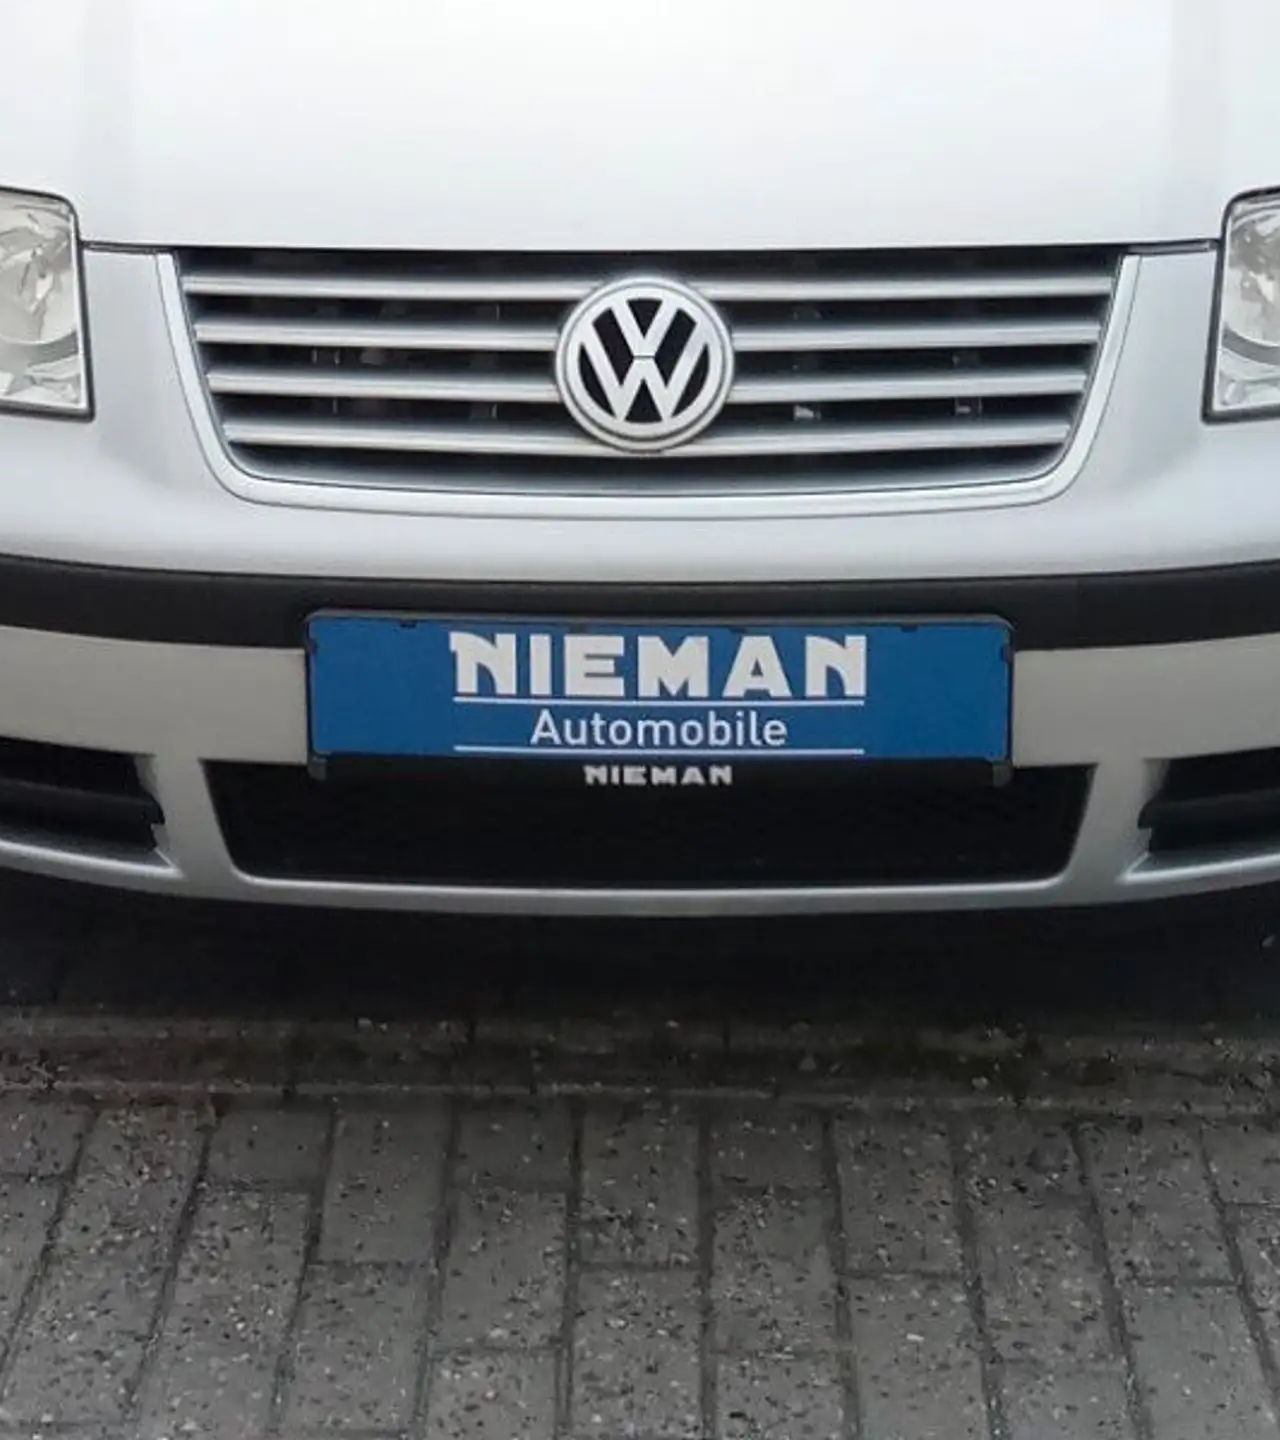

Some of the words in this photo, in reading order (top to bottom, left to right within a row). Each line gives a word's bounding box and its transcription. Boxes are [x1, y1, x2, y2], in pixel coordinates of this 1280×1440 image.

[567, 288, 723, 437] VW
[449, 631, 868, 698] NIEMAN
[530, 707, 788, 748] Automobile
[582, 764, 733, 786] NIEMAN
